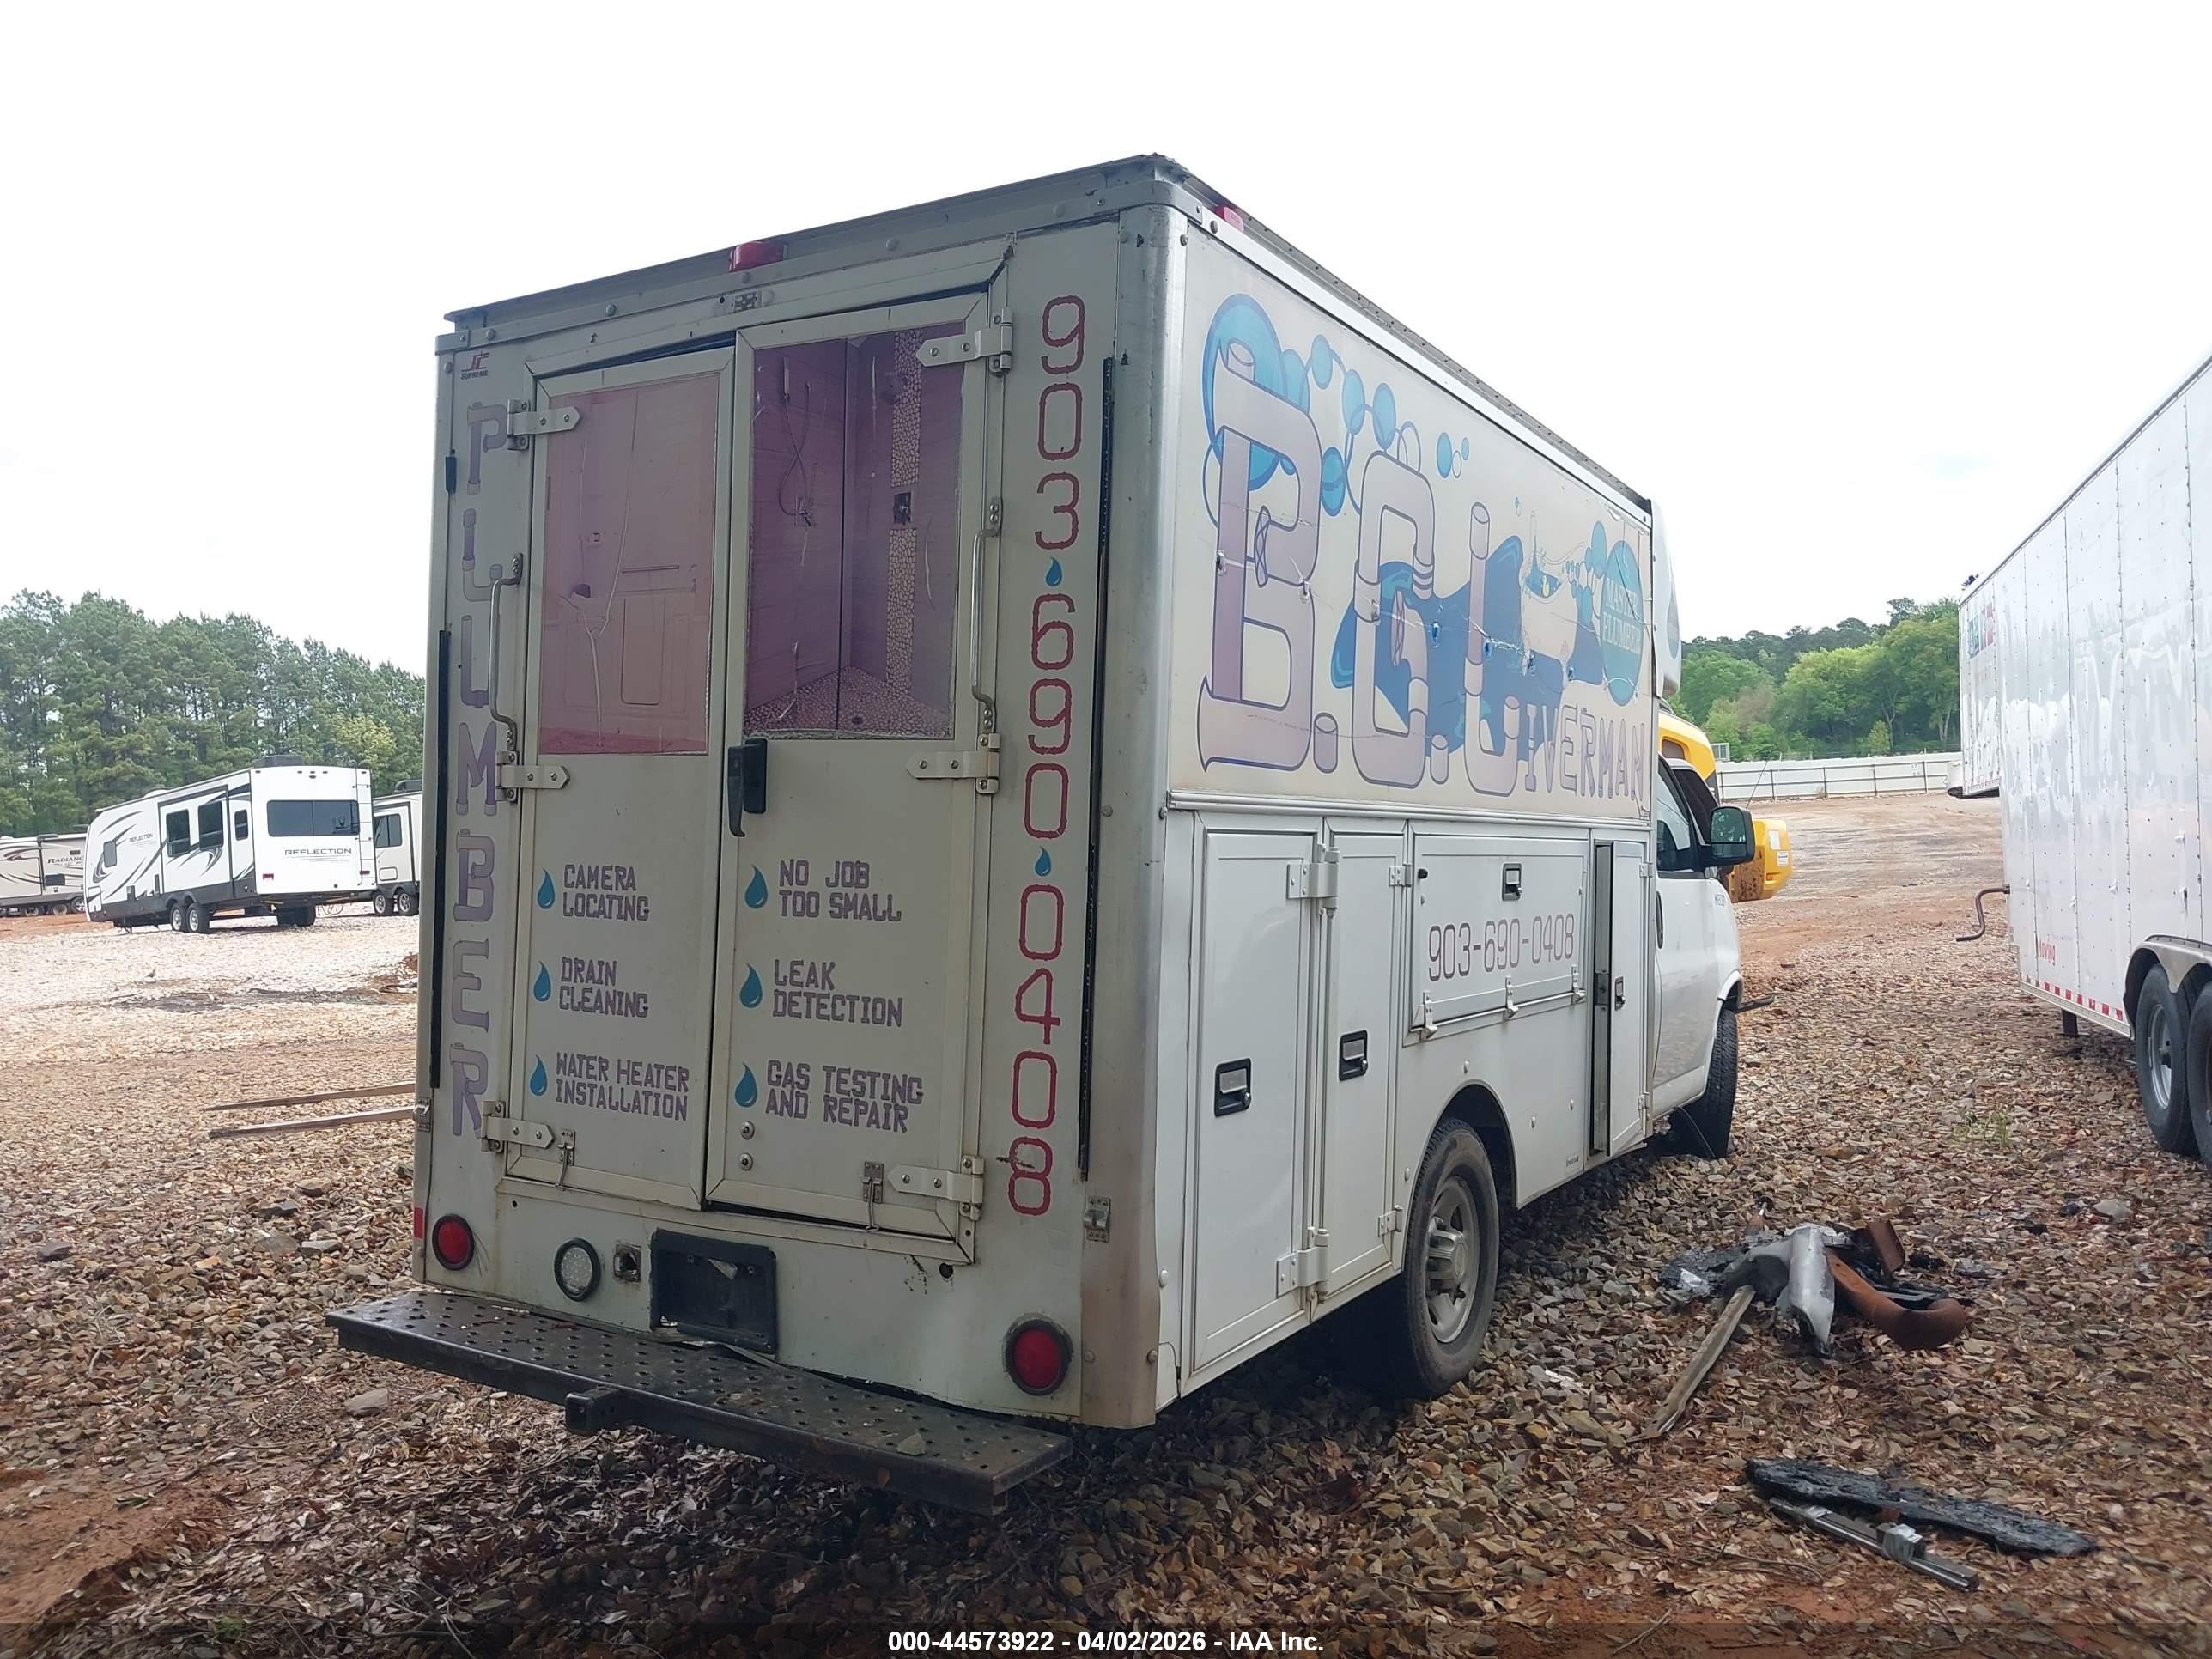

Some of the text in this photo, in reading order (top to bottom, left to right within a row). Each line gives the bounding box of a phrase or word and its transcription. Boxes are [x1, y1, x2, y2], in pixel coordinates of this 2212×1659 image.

[1606, 576, 1639, 620] MASTER
[1601, 611, 1641, 655] PLUMBER
[284, 848, 352, 856] REFLECTION
[563, 864, 637, 892] CAMERA
[779, 859, 870, 889] NO JOB
[562, 892, 650, 921] LOCATING
[779, 890, 902, 922] TOO SMALL
[1428, 913, 1575, 981] 903-690-0408
[561, 957, 617, 987] DRAIN
[774, 959, 836, 991] LEAK
[558, 986, 649, 1018] CLEANING
[772, 989, 903, 1028] DETECTION
[556, 1051, 690, 1092] WATER HEATER
[767, 1060, 924, 1105] GAS TESTING
[556, 1079, 688, 1121] INSTALLATION
[765, 1088, 909, 1133] AND REPAIR
